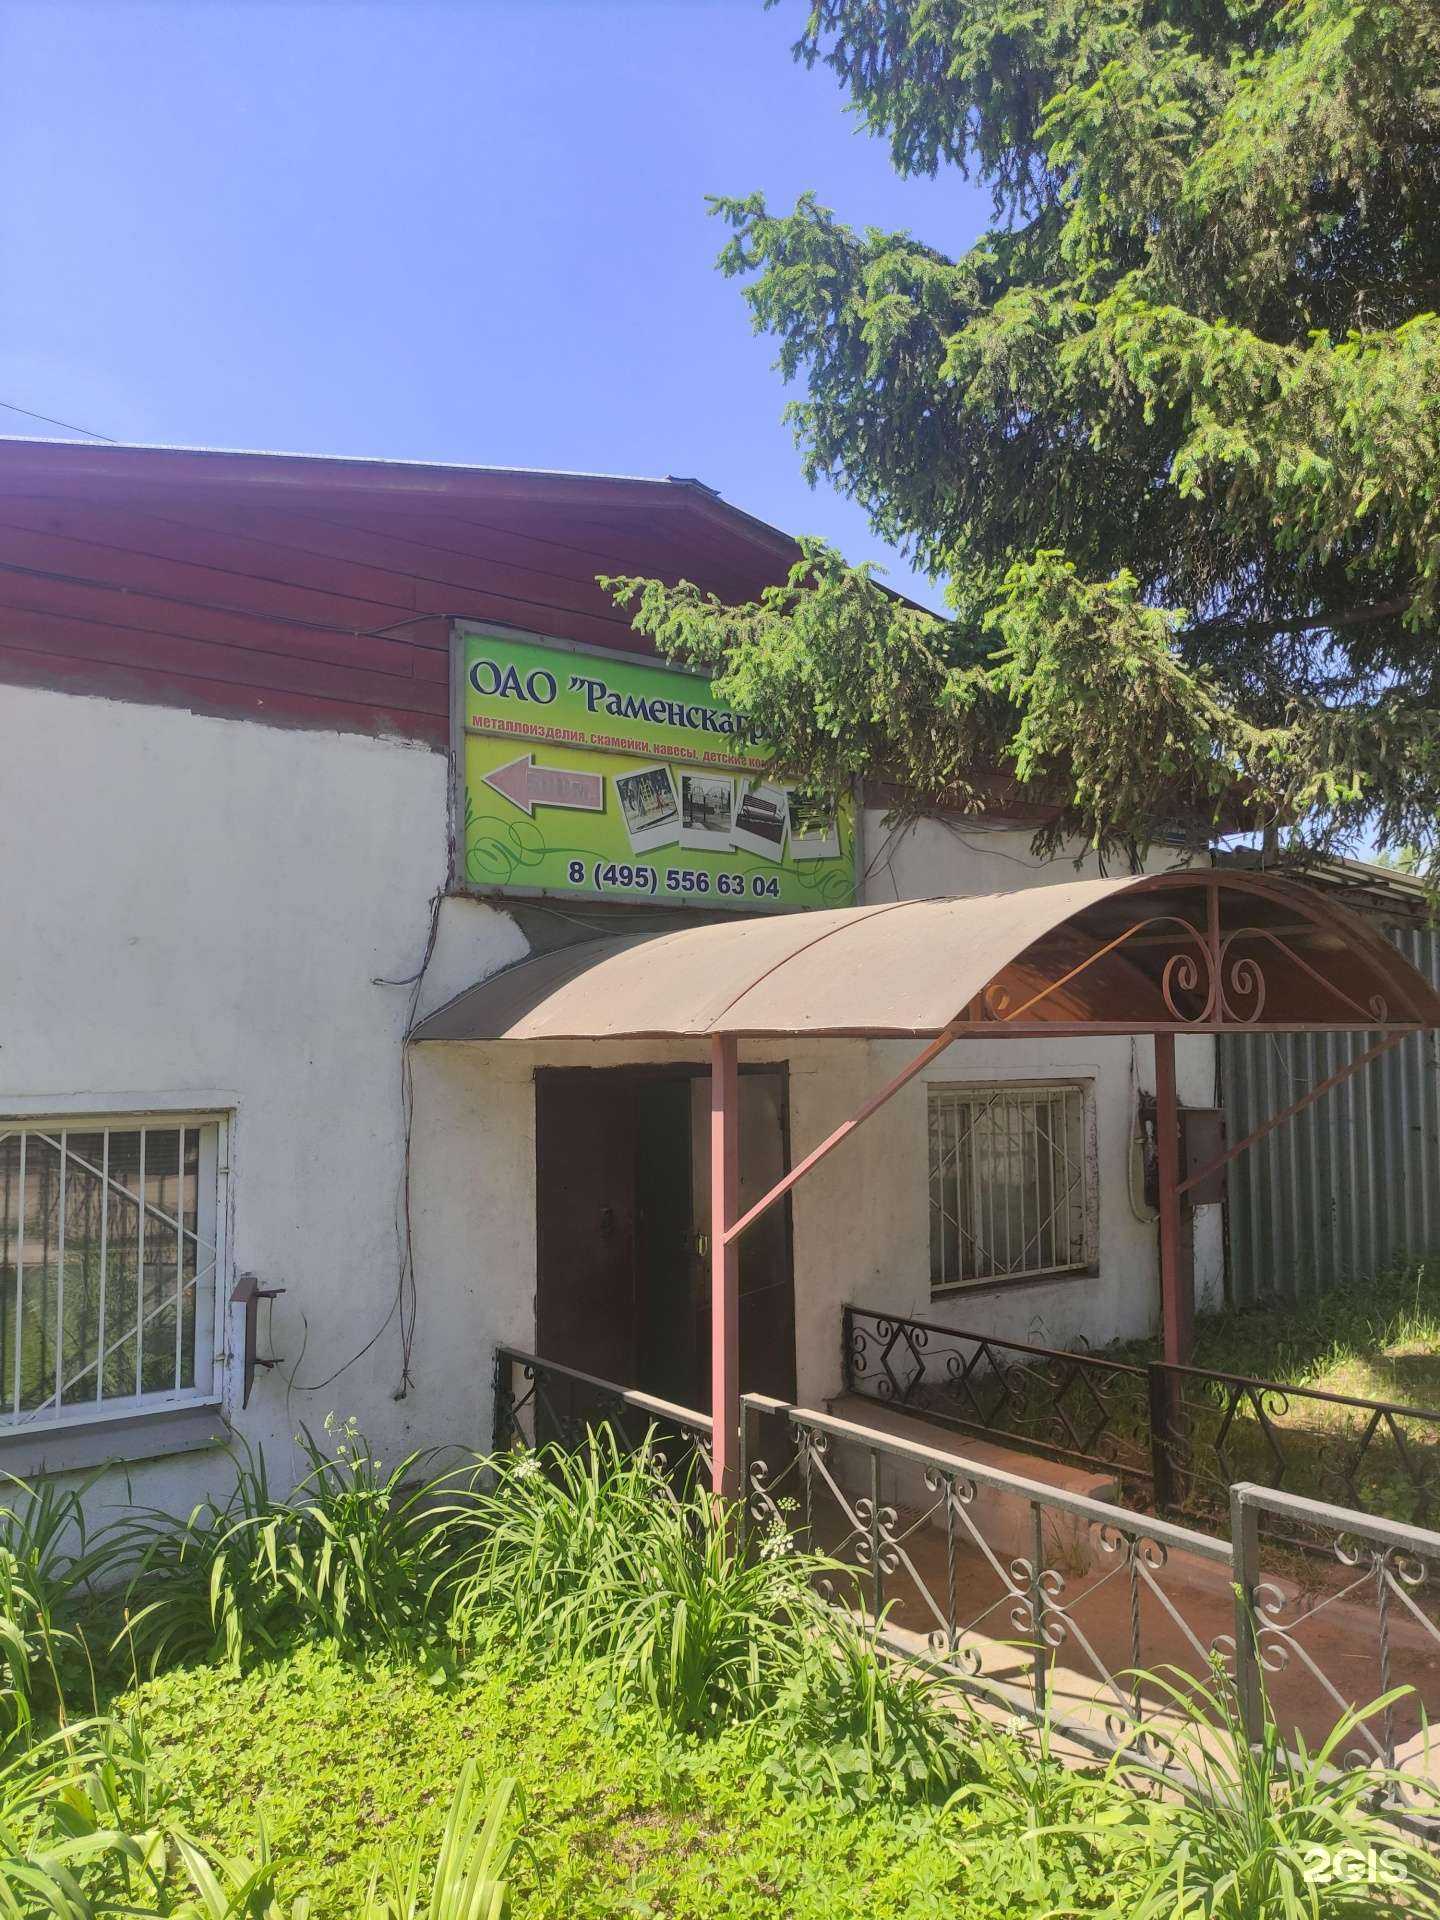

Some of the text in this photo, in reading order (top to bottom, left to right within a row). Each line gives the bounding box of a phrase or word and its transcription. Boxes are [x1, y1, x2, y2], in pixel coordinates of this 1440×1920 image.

[469, 661, 557, 704] ОАО
[472, 715, 588, 743] металлоизделия,
[568, 861, 779, 897] 8 (495) 556 63 04
